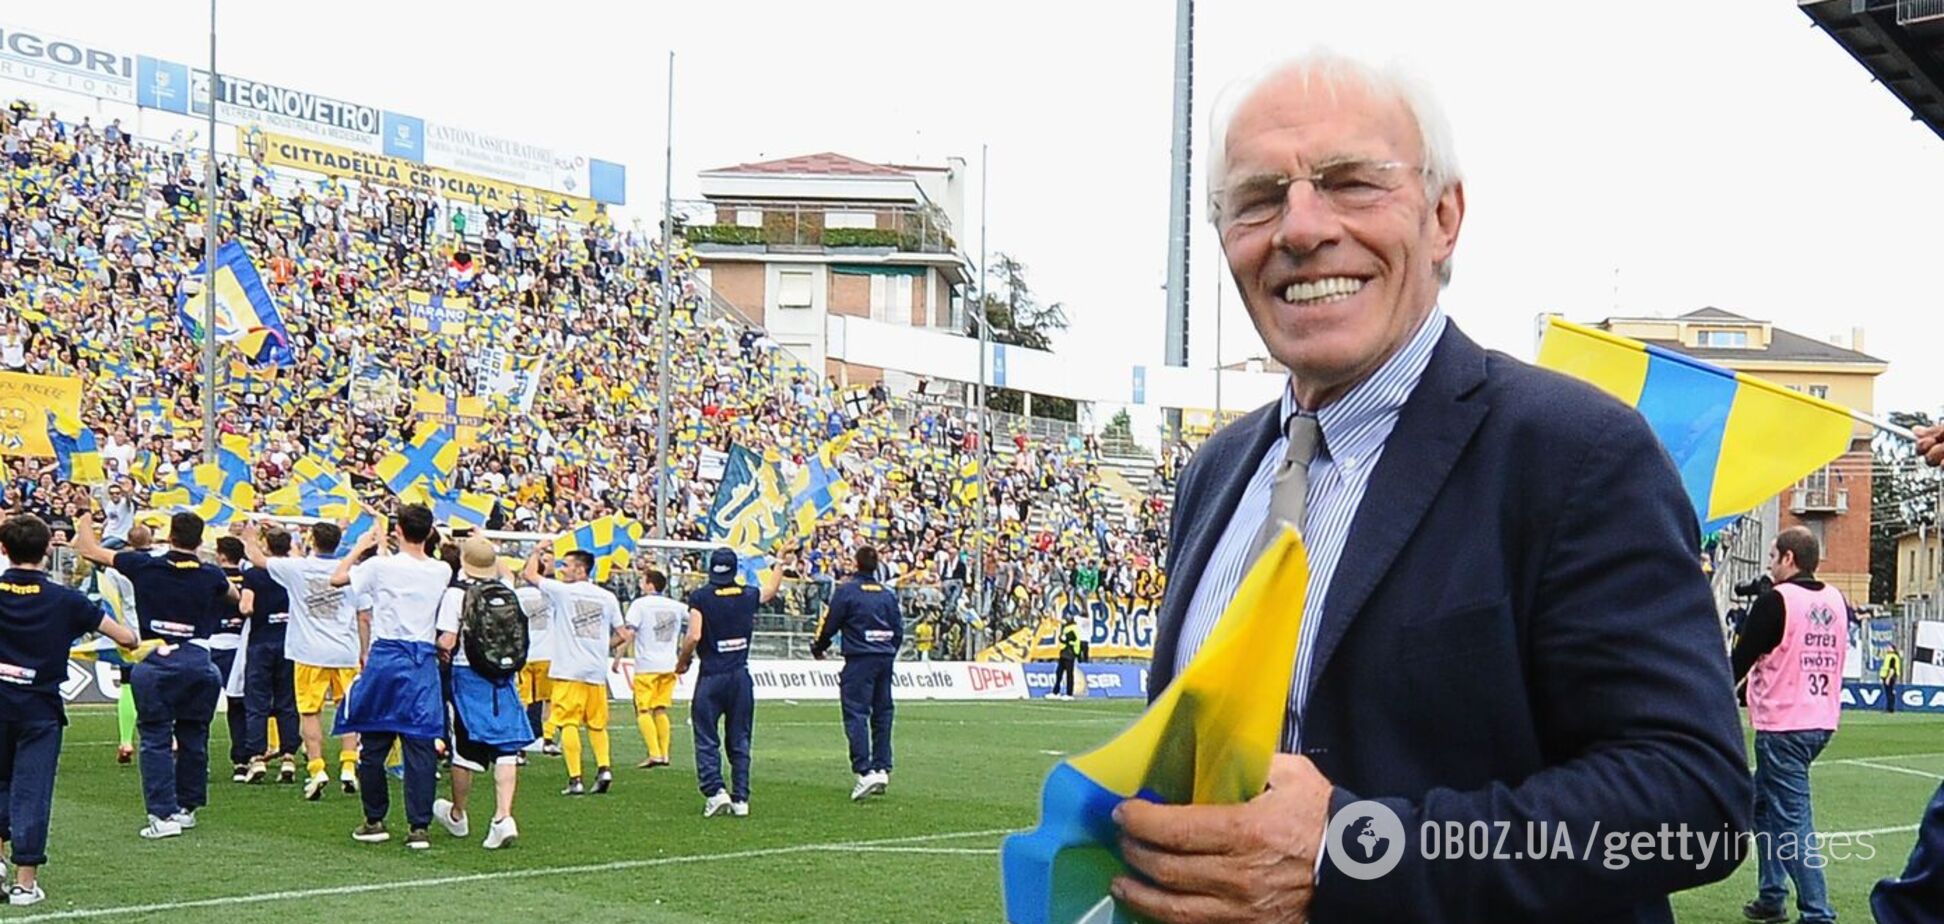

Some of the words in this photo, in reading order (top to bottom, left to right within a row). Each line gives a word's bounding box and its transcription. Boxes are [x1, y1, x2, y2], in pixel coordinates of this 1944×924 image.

[220, 75, 374, 133] TECNOVETRO
[781, 671, 806, 689] per
[968, 665, 1014, 691] OPEM
[1808, 673, 1830, 697] 32
